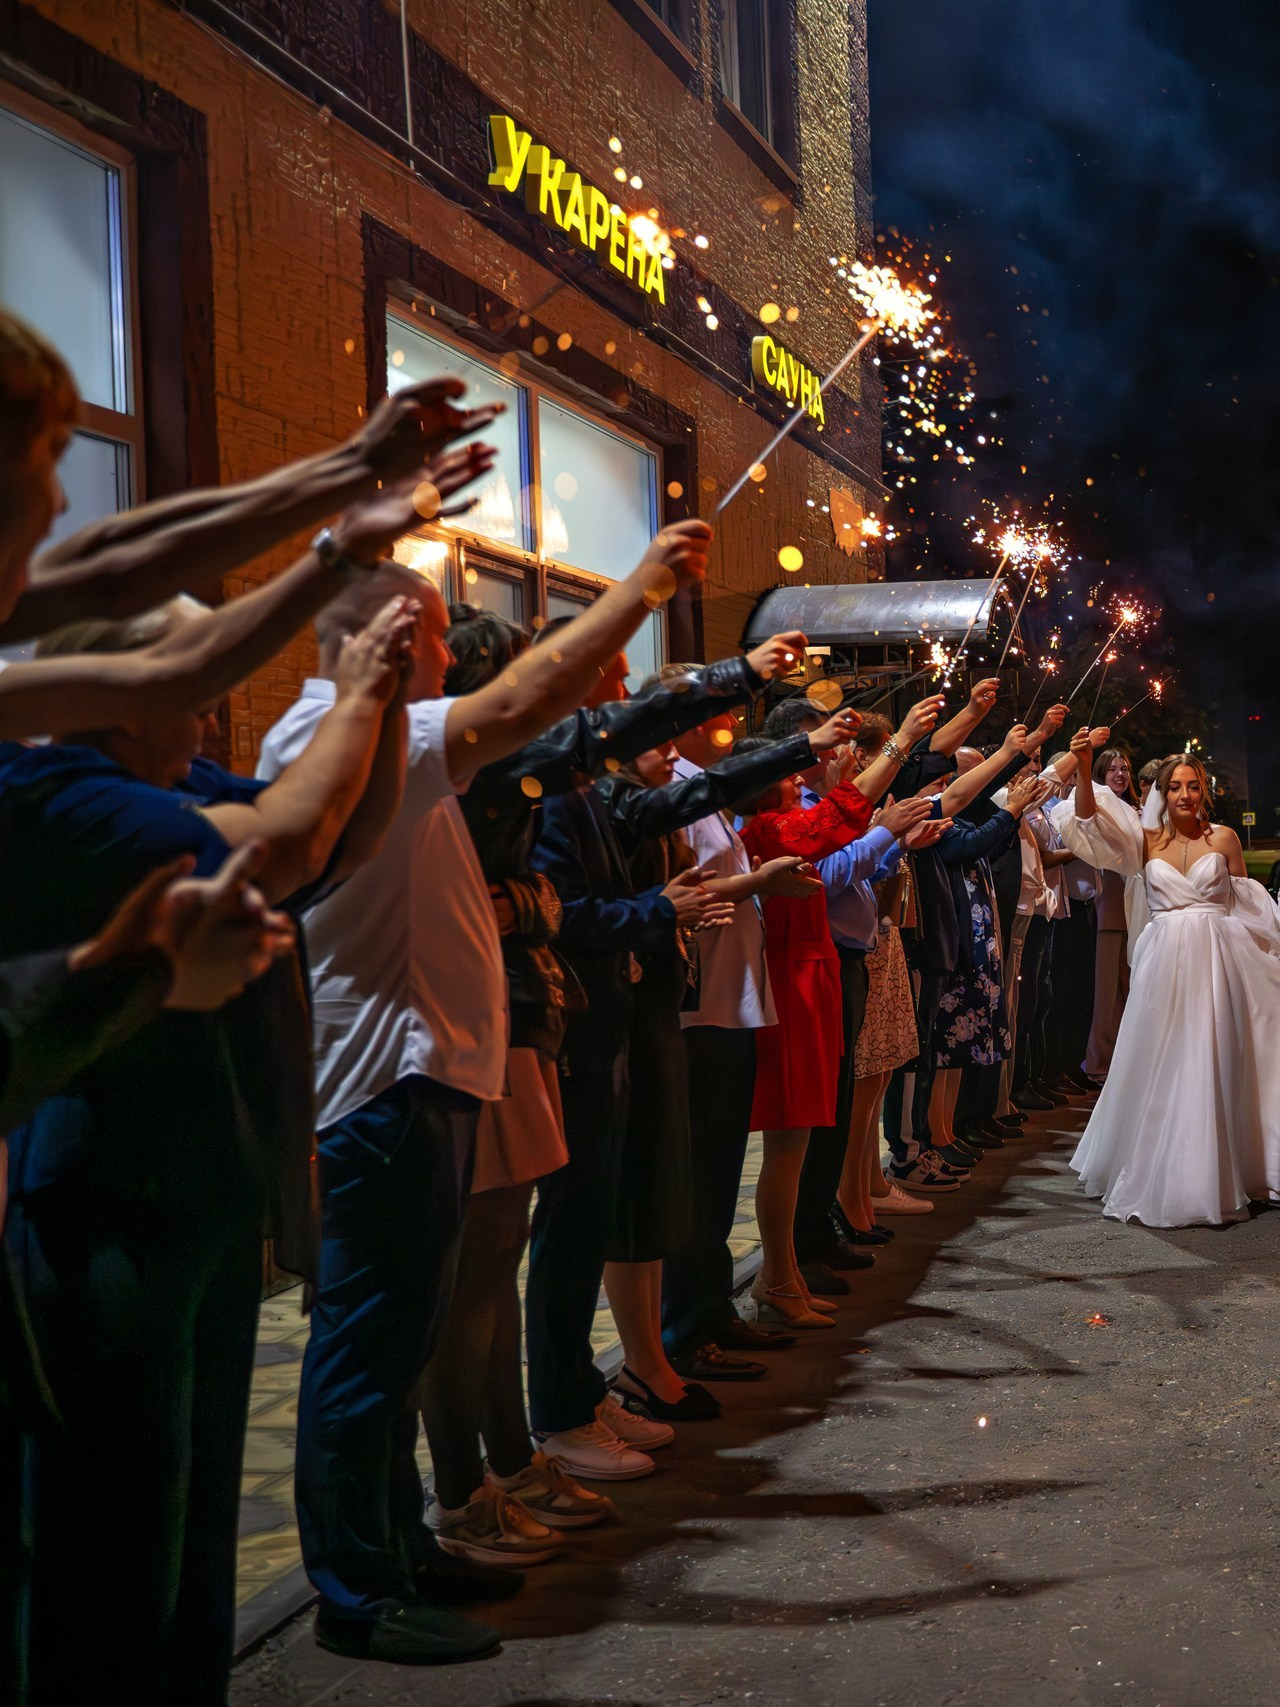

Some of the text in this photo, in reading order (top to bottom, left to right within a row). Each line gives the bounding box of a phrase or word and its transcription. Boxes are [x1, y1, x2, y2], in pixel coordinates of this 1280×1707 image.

[497, 115, 666, 306] У КАРЕНА
[759, 335, 825, 425] САУНА
